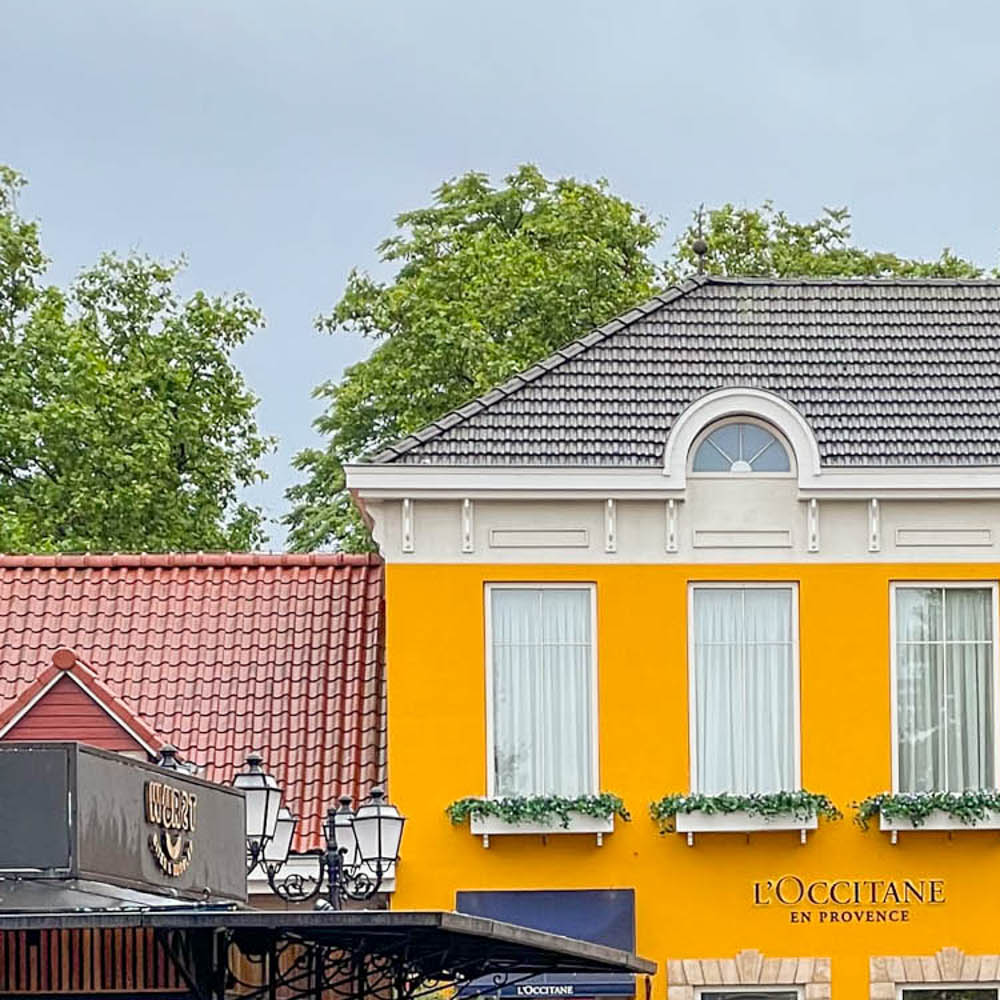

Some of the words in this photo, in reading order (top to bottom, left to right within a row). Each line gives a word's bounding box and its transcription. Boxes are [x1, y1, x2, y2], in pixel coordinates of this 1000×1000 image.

[754, 875, 946, 905] L'OCCITANE
[791, 911, 811, 923] EN
[819, 910, 909, 923] PROVENCE
[516, 984, 575, 996] L'OCCITANE
